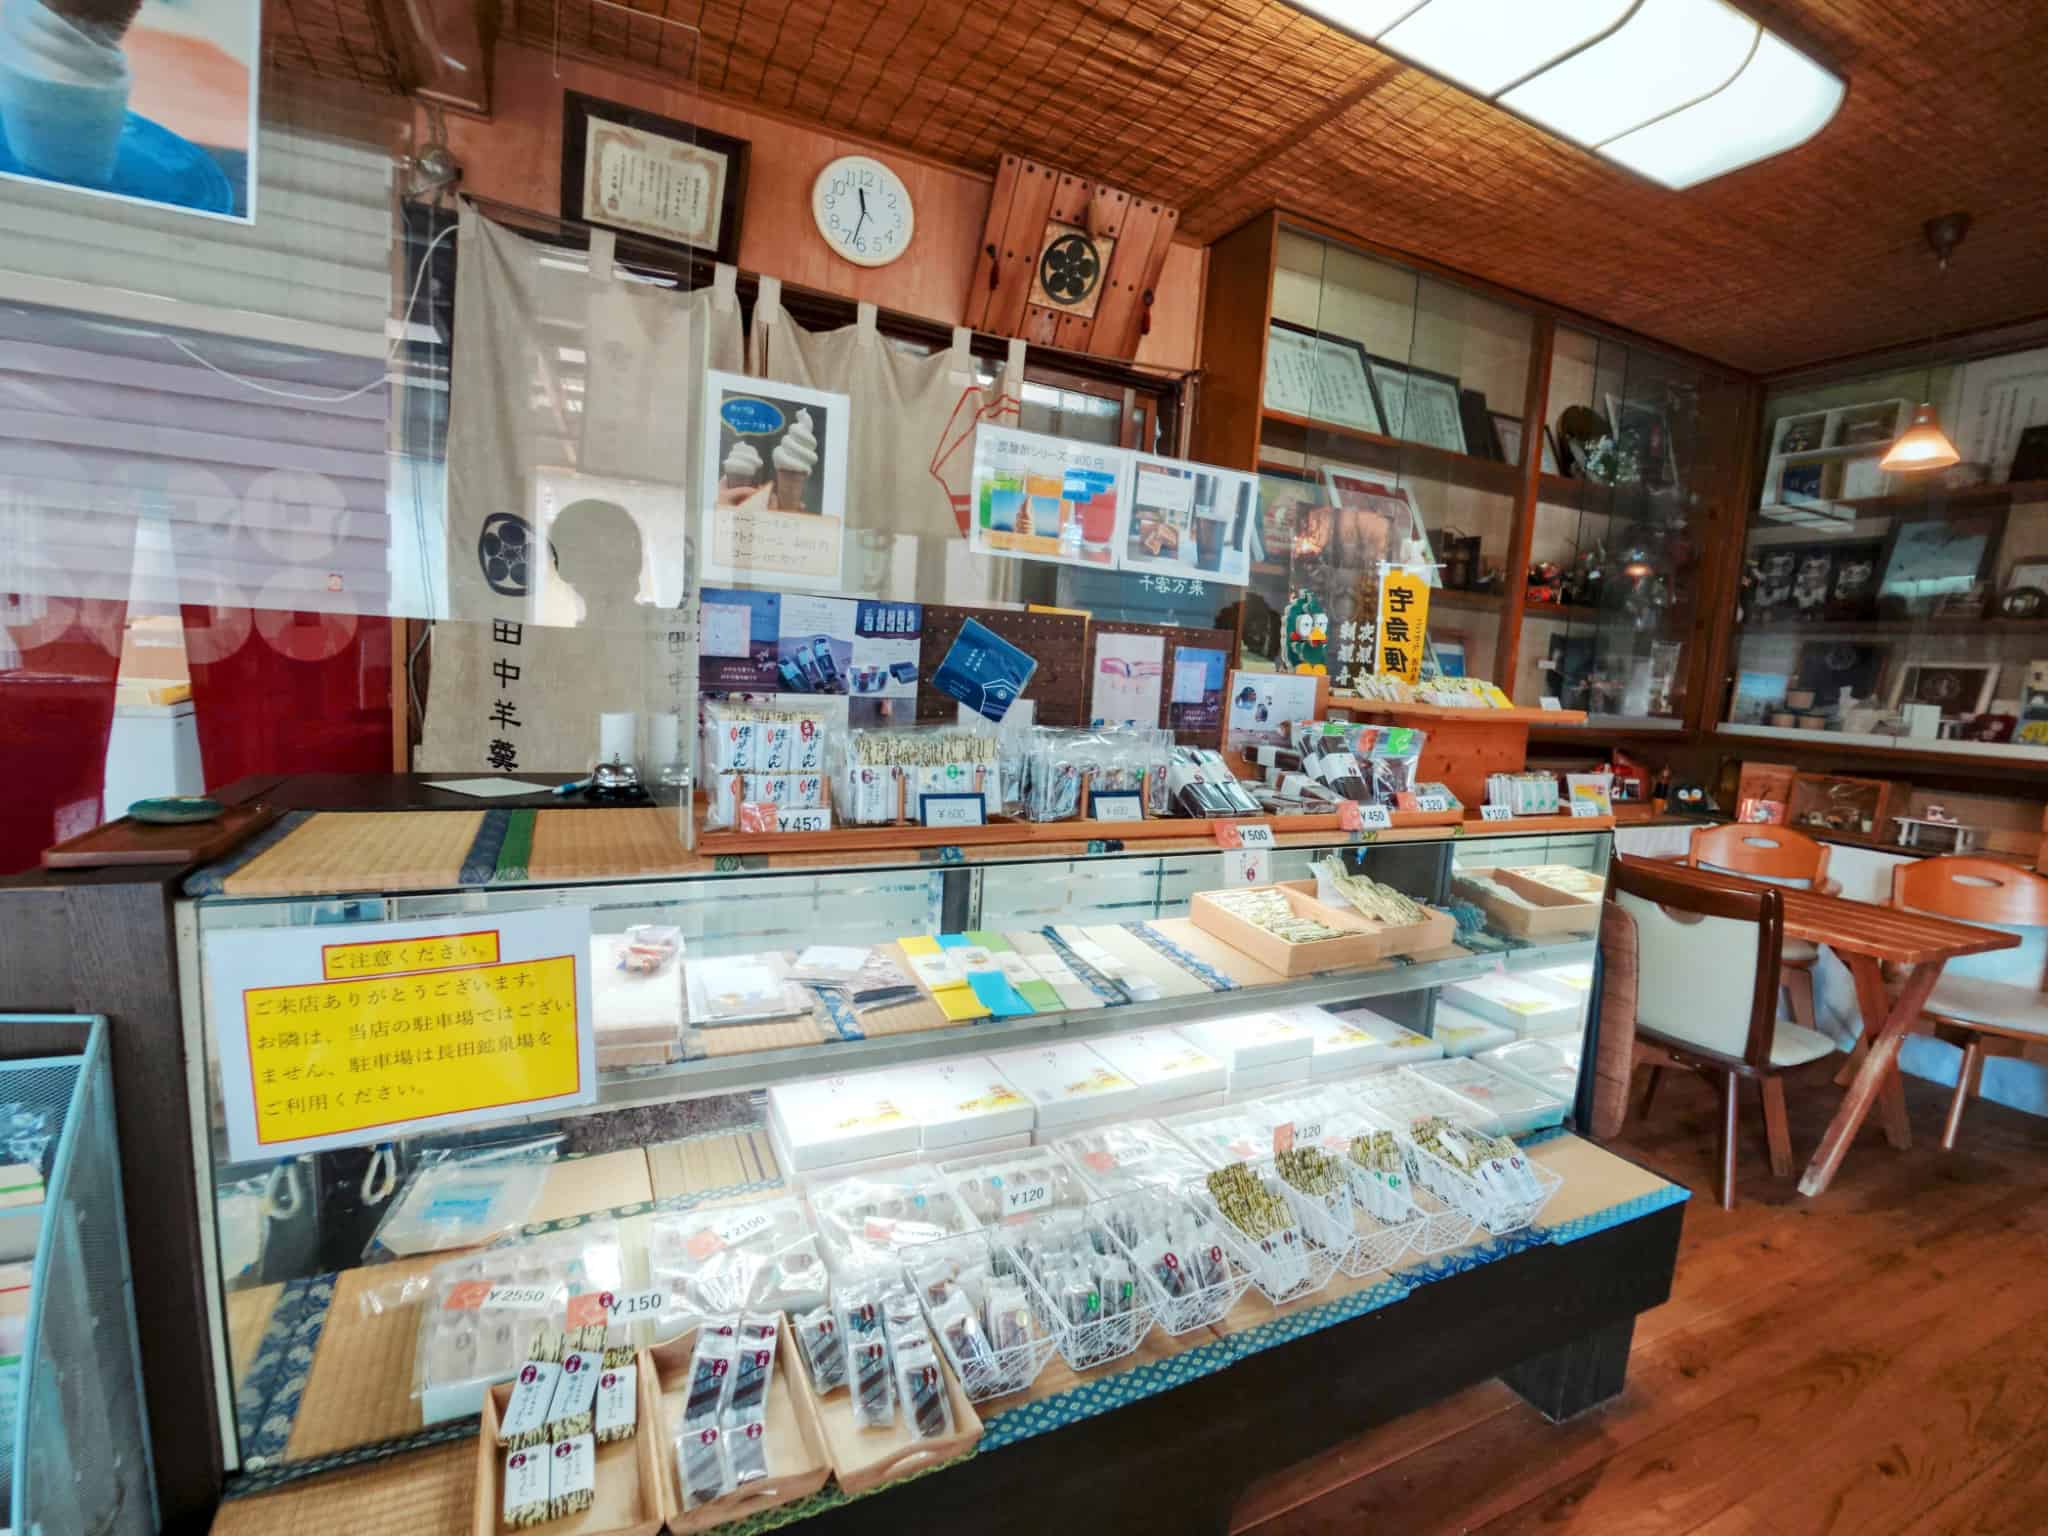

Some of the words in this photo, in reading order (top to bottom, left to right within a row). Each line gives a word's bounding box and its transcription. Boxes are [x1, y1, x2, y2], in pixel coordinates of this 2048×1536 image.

[860, 168, 873, 188] 12
[832, 178, 846, 197] 10
[824, 193, 836, 210] 9
[887, 192, 896, 210] 2
[831, 214, 841, 230] 8
